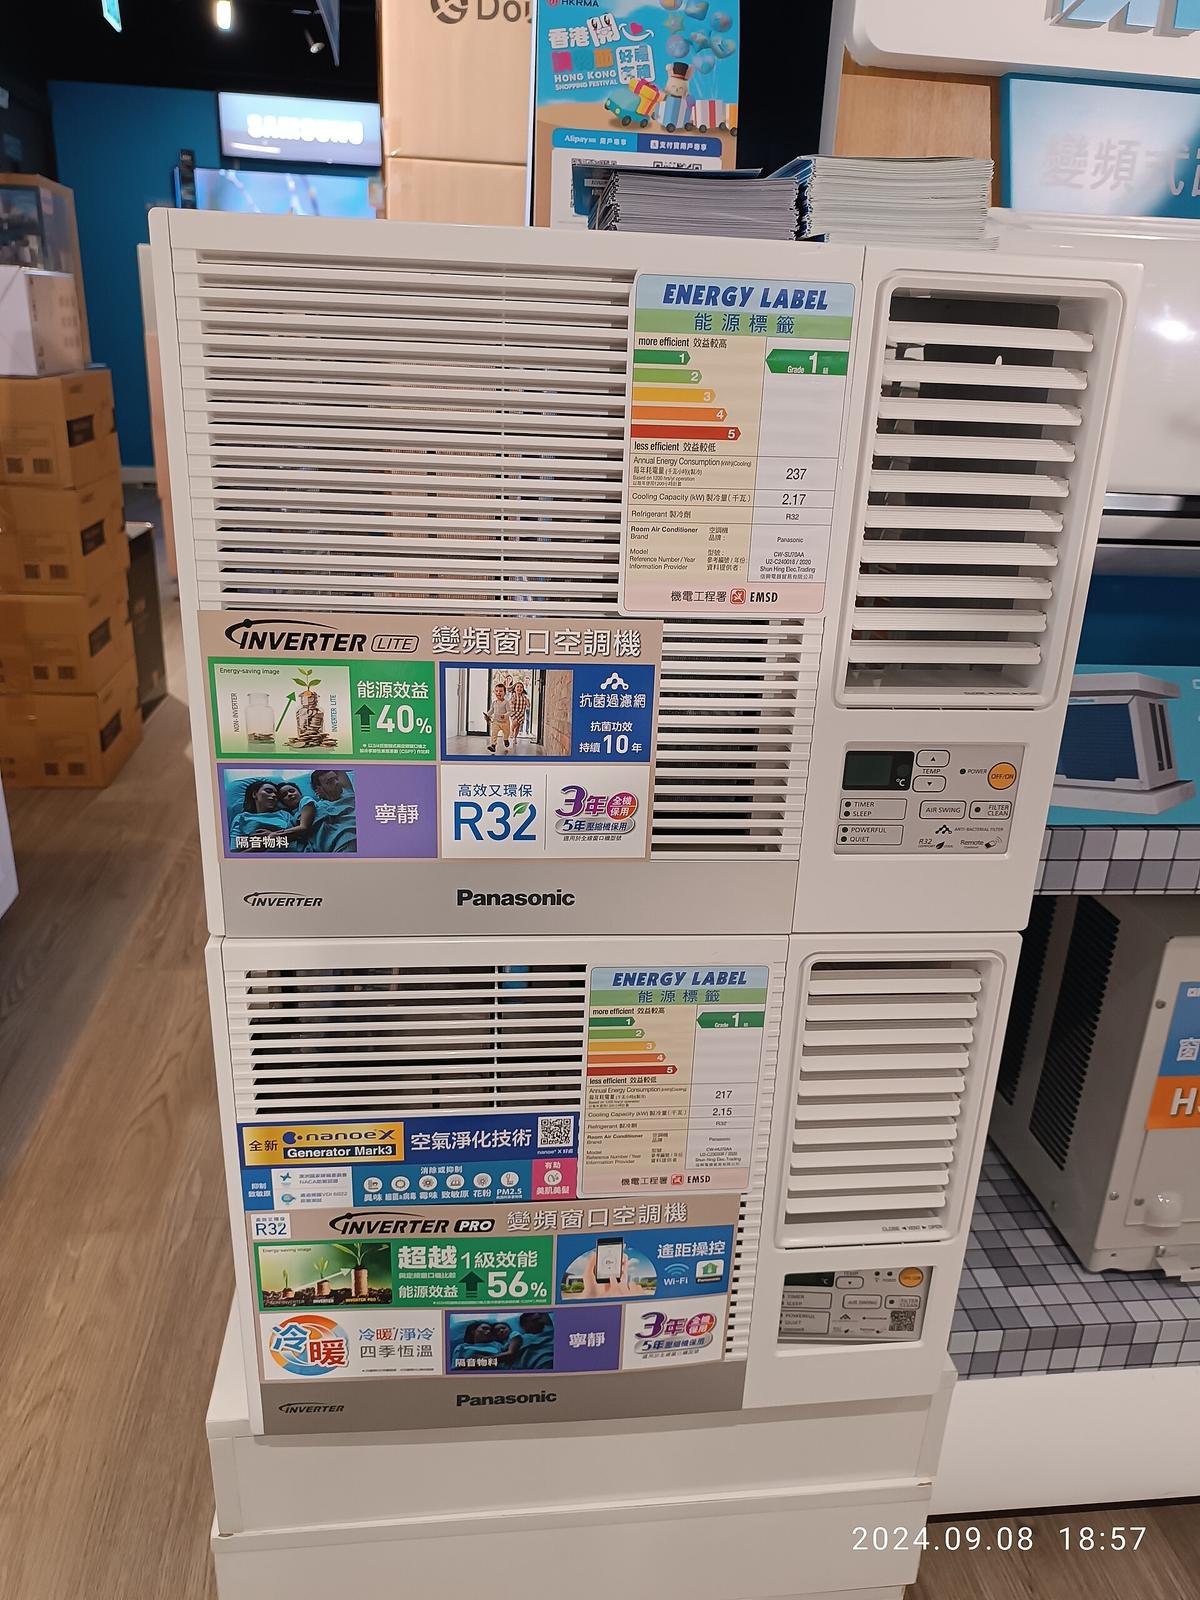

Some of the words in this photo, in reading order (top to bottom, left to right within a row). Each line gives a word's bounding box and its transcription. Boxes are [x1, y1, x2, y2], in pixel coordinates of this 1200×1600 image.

[554, 73, 584, 83] HONG
[587, 70, 617, 80] KONG
[555, 82, 588, 91] SHOPPING
[588, 79, 618, 89] FESTIVAL
[1041, 134, 1200, 196] 變頻式
[663, 284, 754, 308] ENERGY
[760, 287, 828, 311] LABEL
[694, 312, 795, 334] 能源標籤
[638, 338, 657, 347] more
[659, 336, 689, 347] efficient
[693, 338, 727, 349] 效益較高
[679, 354, 686, 363] 1
[787, 366, 804, 374] Grade
[809, 352, 819, 374] 1
[691, 372, 699, 382] 2
[703, 391, 711, 401] 3
[716, 410, 724, 419] 4
[727, 429, 736, 439] 5
[634, 442, 649, 451] less
[650, 442, 679, 452] efficient
[683, 442, 716, 452] 效益較低
[633, 457, 656, 465] Annual
[656, 457, 678, 467] Energy
[679, 458, 720, 467] Consumption
[786, 468, 807, 480] 237
[632, 493, 658, 501] Cooling
[659, 494, 688, 503] Capacity
[690, 494, 704, 502] (kW)
[782, 494, 806, 505] 2.17
[632, 510, 667, 519] Refrigerant
[670, 510, 691, 519] 製冷劑
[670, 591, 727, 602] 機電工程署
[750, 592, 778, 603] EMSD
[234, 626, 367, 652] INVERTER
[377, 638, 412, 650] LITE
[432, 626, 641, 657] 變頻窗口空調機
[220, 667, 259, 675] Energy-saving
[357, 681, 429, 699] 能源效益
[579, 693, 646, 708] 抗菌過濾網
[376, 704, 432, 734] 40%
[590, 721, 632, 732] 抗菌功效
[458, 784, 533, 797] 高效又環保
[374, 803, 420, 824] 寧靜
[454, 801, 537, 841] R32
[235, 836, 289, 849] 隔音物料
[246, 895, 323, 907] INVERTER
[457, 889, 576, 906] Panasonic
[612, 972, 686, 987] ENERGY
[692, 971, 747, 986] LABEL
[626, 1018, 631, 1026] 1
[732, 1013, 740, 1027] 1
[590, 1077, 601, 1085] less
[715, 1090, 732, 1099] 217
[1170, 1087, 1200, 1116] H
[713, 1107, 732, 1116] 2.15
[249, 1139, 278, 1152] 全新
[411, 1128, 532, 1151] 空氣淨化技術
[287, 1147, 350, 1158] Generator
[354, 1145, 392, 1156] Mark3
[544, 1161, 561, 1169] 有助
[687, 1175, 711, 1184] EMSD
[473, 1189, 491, 1198] 花粉
[335, 1216, 450, 1234] INVERTER
[458, 1220, 493, 1232] PRO
[507, 1202, 687, 1232] 變頻窗口空調機
[255, 1222, 287, 1236] R32
[657, 1241, 726, 1259] 遙距操控
[398, 1245, 458, 1269] 超越
[487, 1271, 548, 1298] 56%
[664, 1277, 688, 1286] Wi-Fi
[399, 1285, 459, 1299] 能源效益
[272, 1323, 348, 1367] 冷暖
[569, 1331, 605, 1348] 寧靜
[455, 1358, 498, 1367] 隔音物料
[456, 1390, 557, 1406] Panasonic
[281, 1403, 344, 1414] INVERTER
